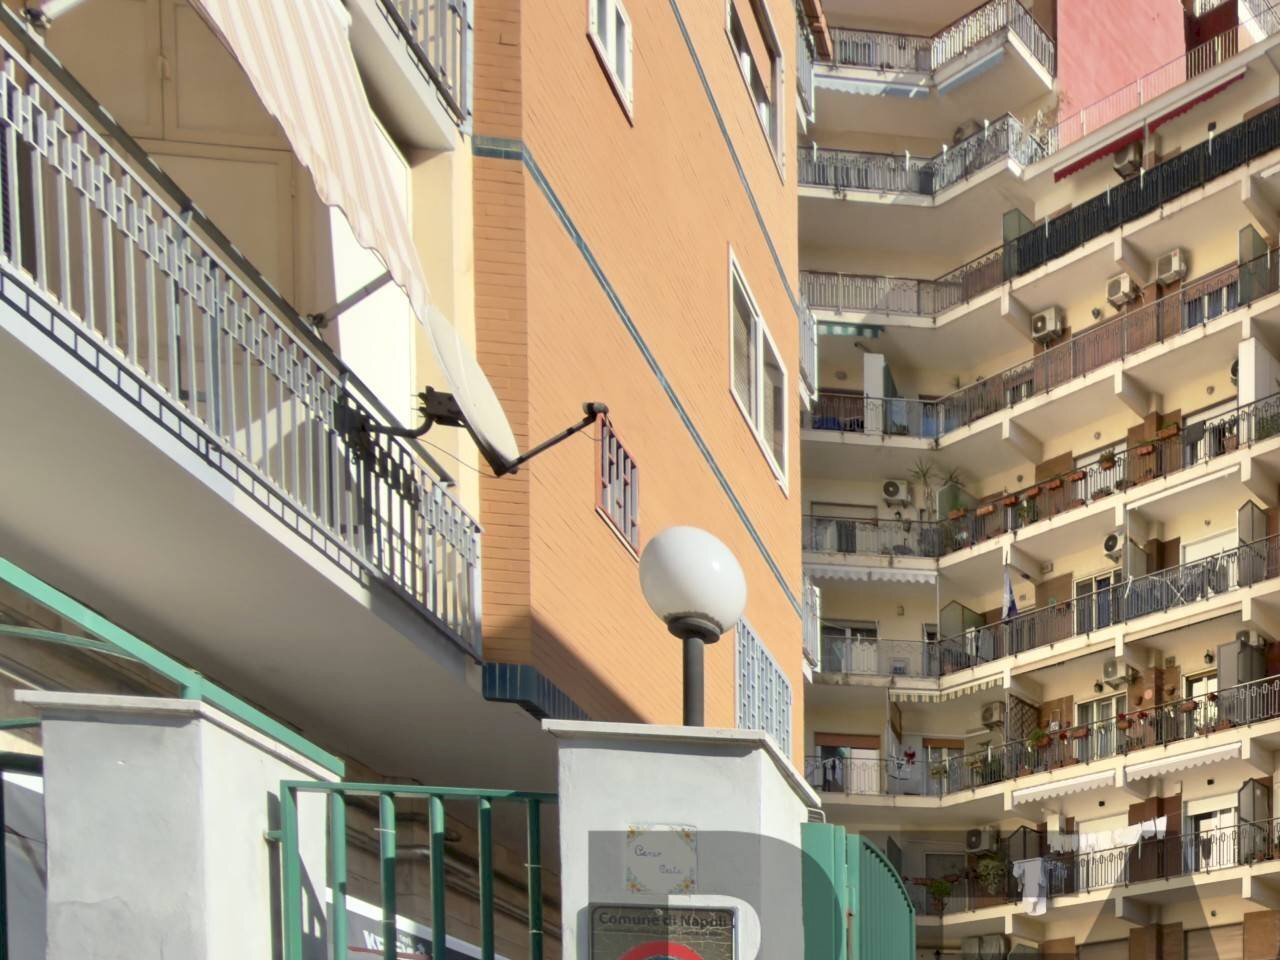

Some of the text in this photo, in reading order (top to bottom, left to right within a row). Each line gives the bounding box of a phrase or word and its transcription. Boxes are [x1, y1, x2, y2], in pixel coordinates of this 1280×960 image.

[599, 912, 727, 929] Comune di Napoli
